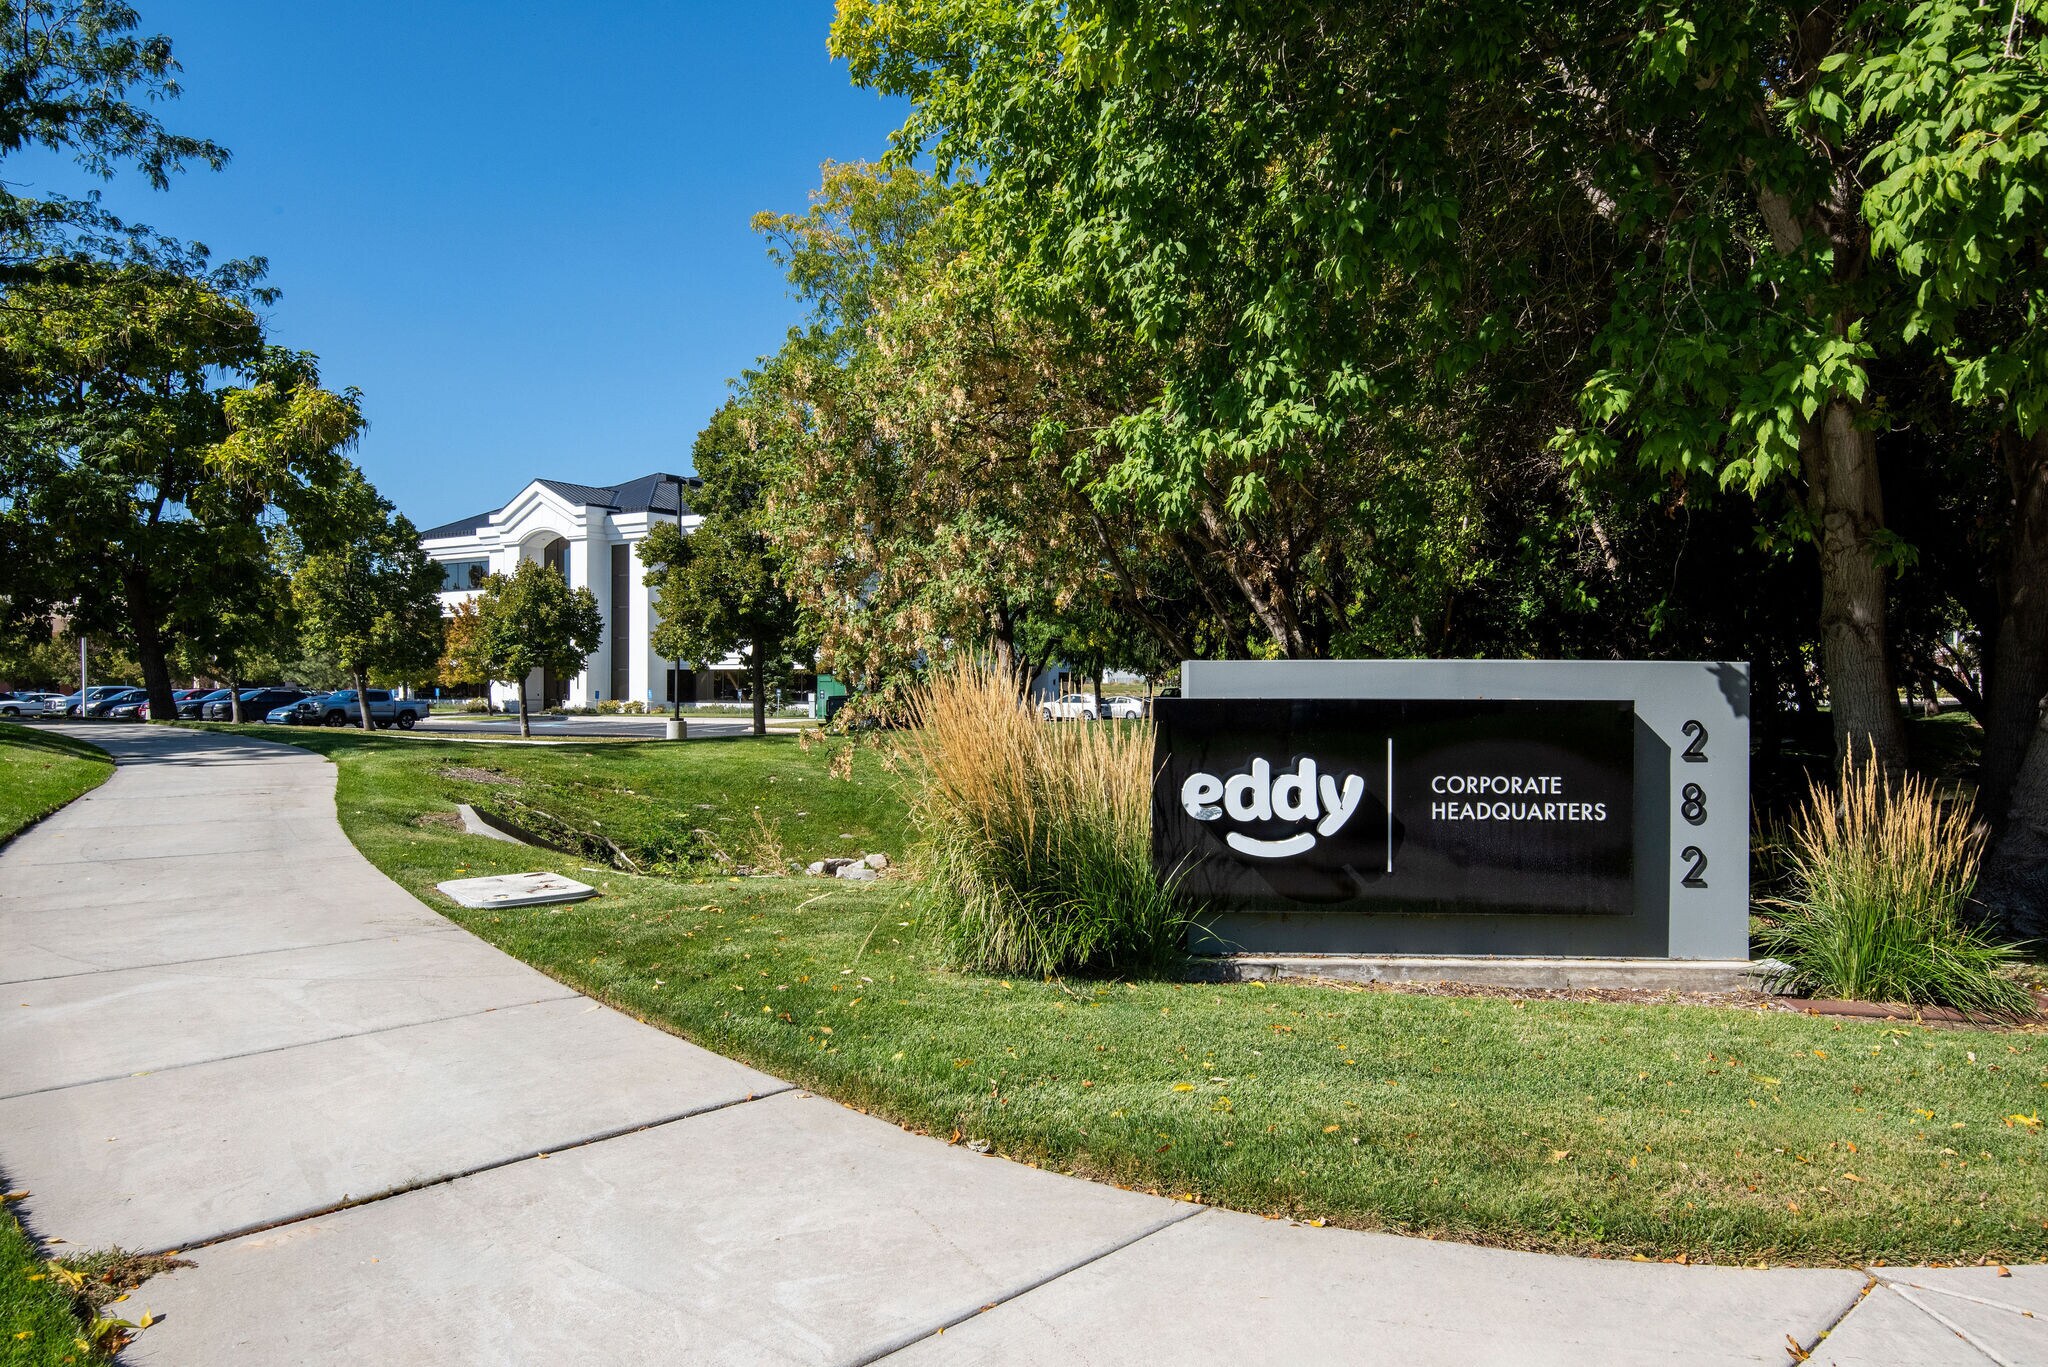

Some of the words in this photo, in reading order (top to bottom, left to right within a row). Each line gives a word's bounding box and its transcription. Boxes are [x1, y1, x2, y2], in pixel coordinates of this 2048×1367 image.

[1431, 775, 1562, 795] CORPORATE
[1181, 757, 1365, 837] eddy
[1431, 801, 1607, 821] HEADQUARTERS
